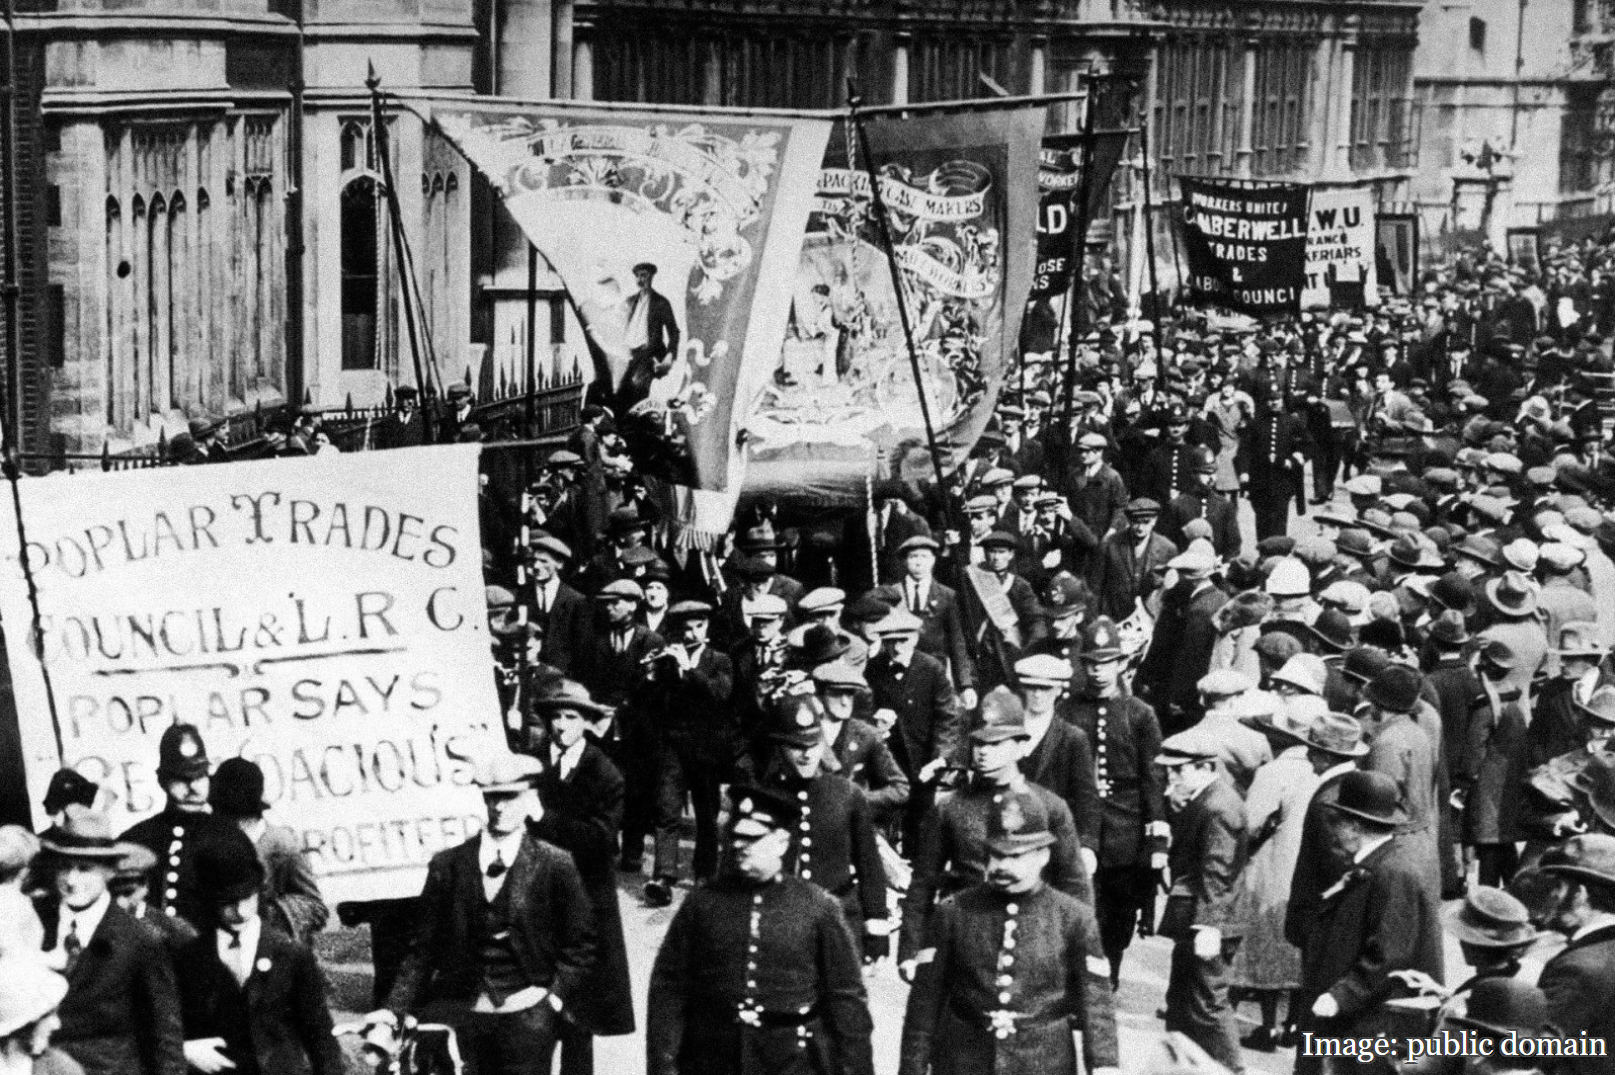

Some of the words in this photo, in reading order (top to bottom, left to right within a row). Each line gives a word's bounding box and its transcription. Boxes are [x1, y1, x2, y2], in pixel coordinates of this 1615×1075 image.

[823, 172, 886, 194] PACKIG
[926, 200, 982, 215] MAKERS
[1192, 192, 1242, 213] WORKERS
[1208, 241, 1267, 262] TRADES
[1233, 287, 1295, 304] COUNCI
[6, 505, 219, 578] POPLAR
[229, 491, 459, 568] TRADES
[254, 612, 284, 649] &
[292, 671, 442, 720] SAYS
[284, 815, 484, 864] ROFITEE
